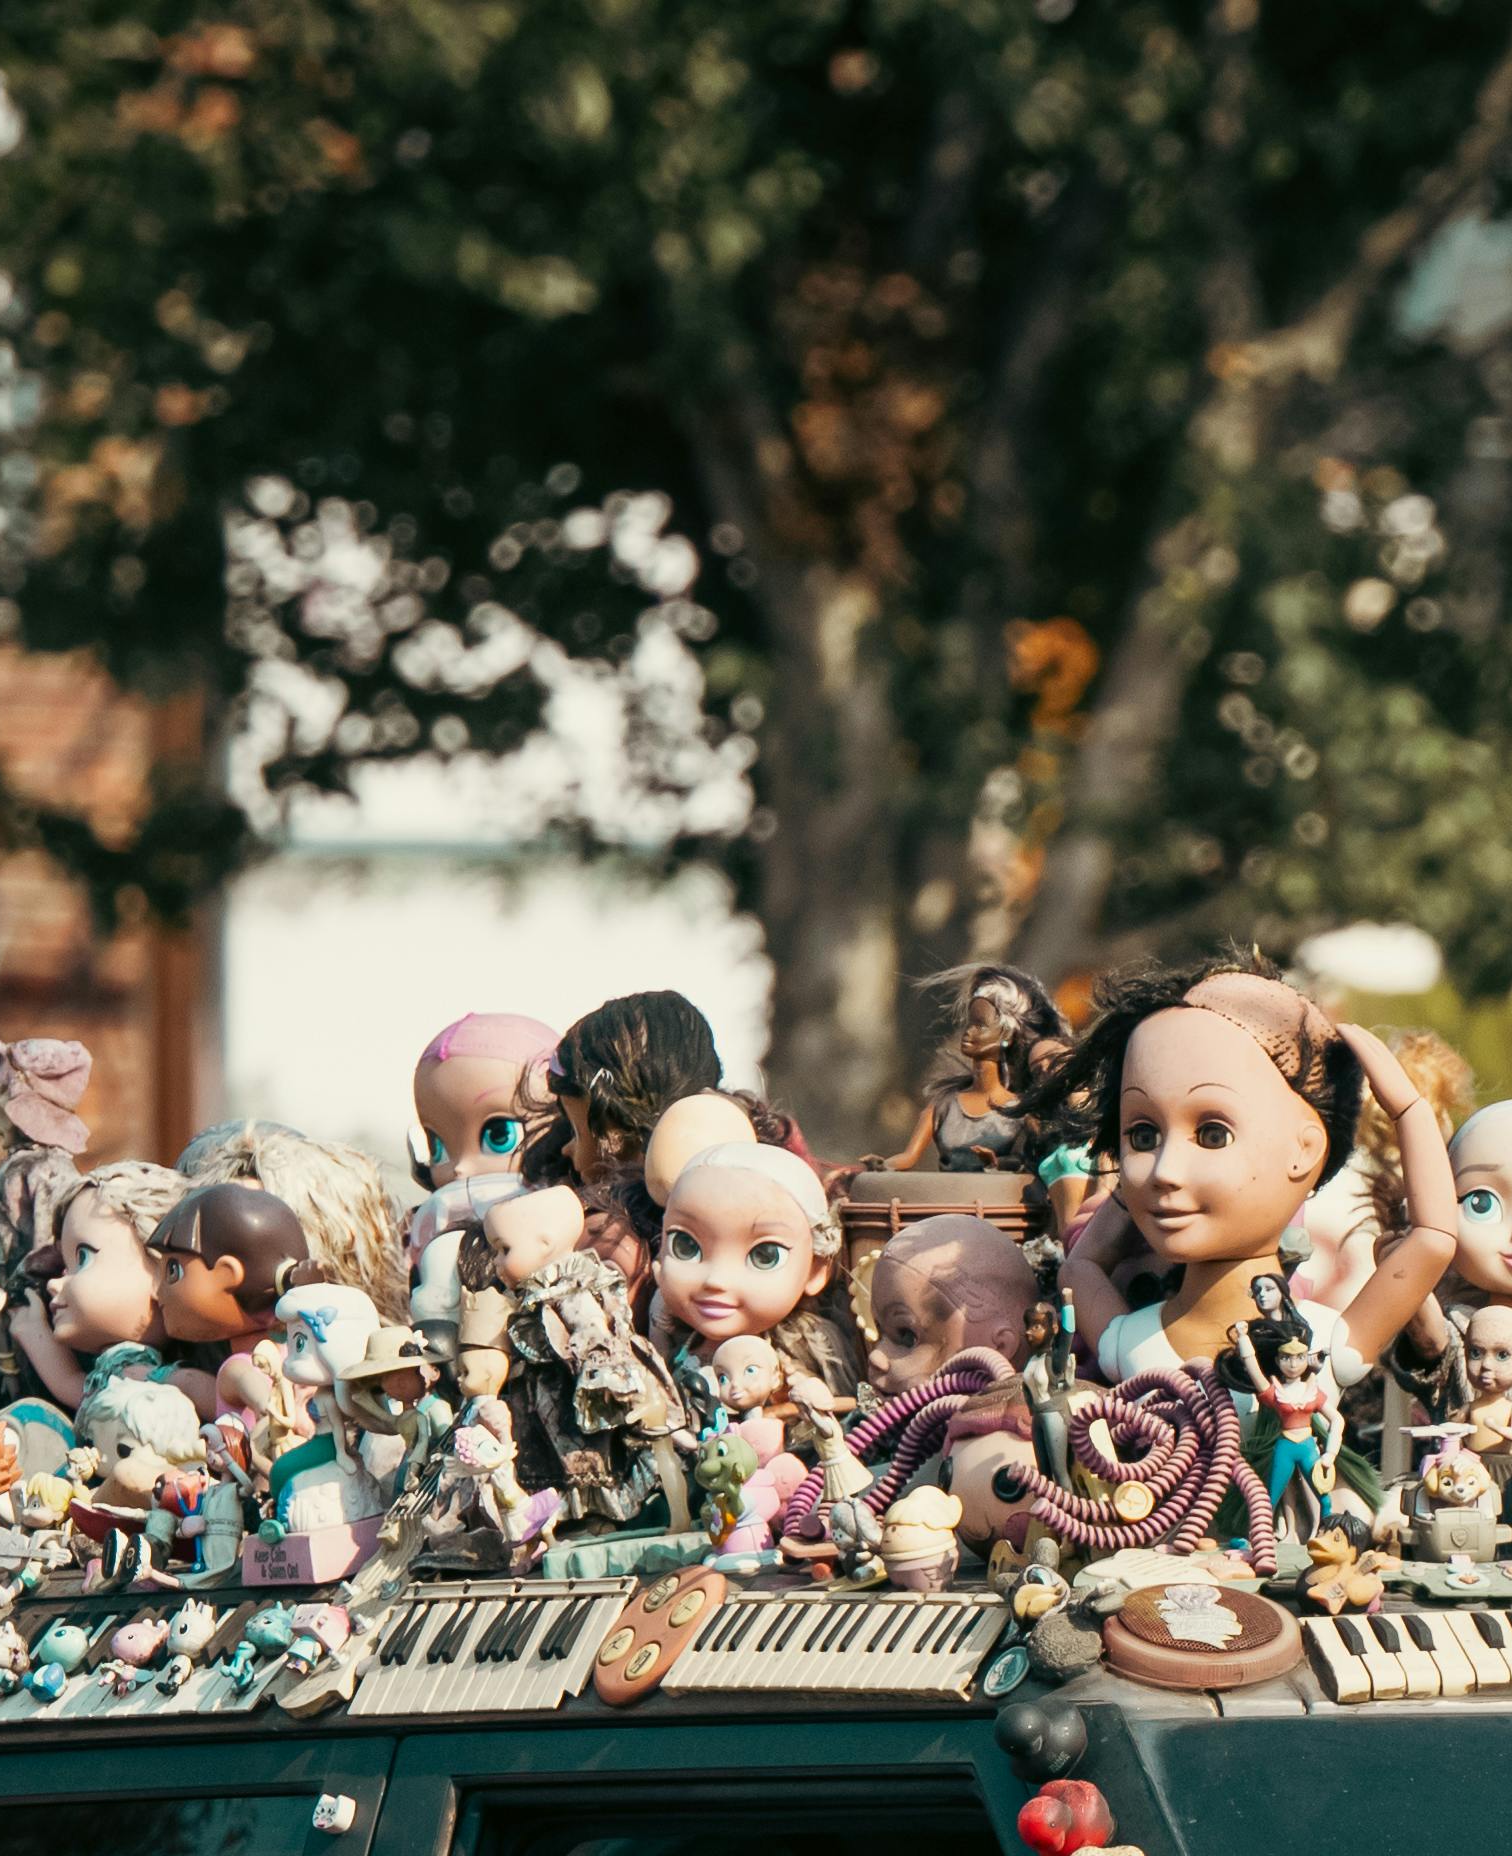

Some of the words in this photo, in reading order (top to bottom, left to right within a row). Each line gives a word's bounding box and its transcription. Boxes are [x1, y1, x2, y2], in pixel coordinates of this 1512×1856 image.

[254, 1550, 269, 1563] Keep
[270, 1547, 287, 1562] Calm
[268, 1564, 286, 1579] Swim
